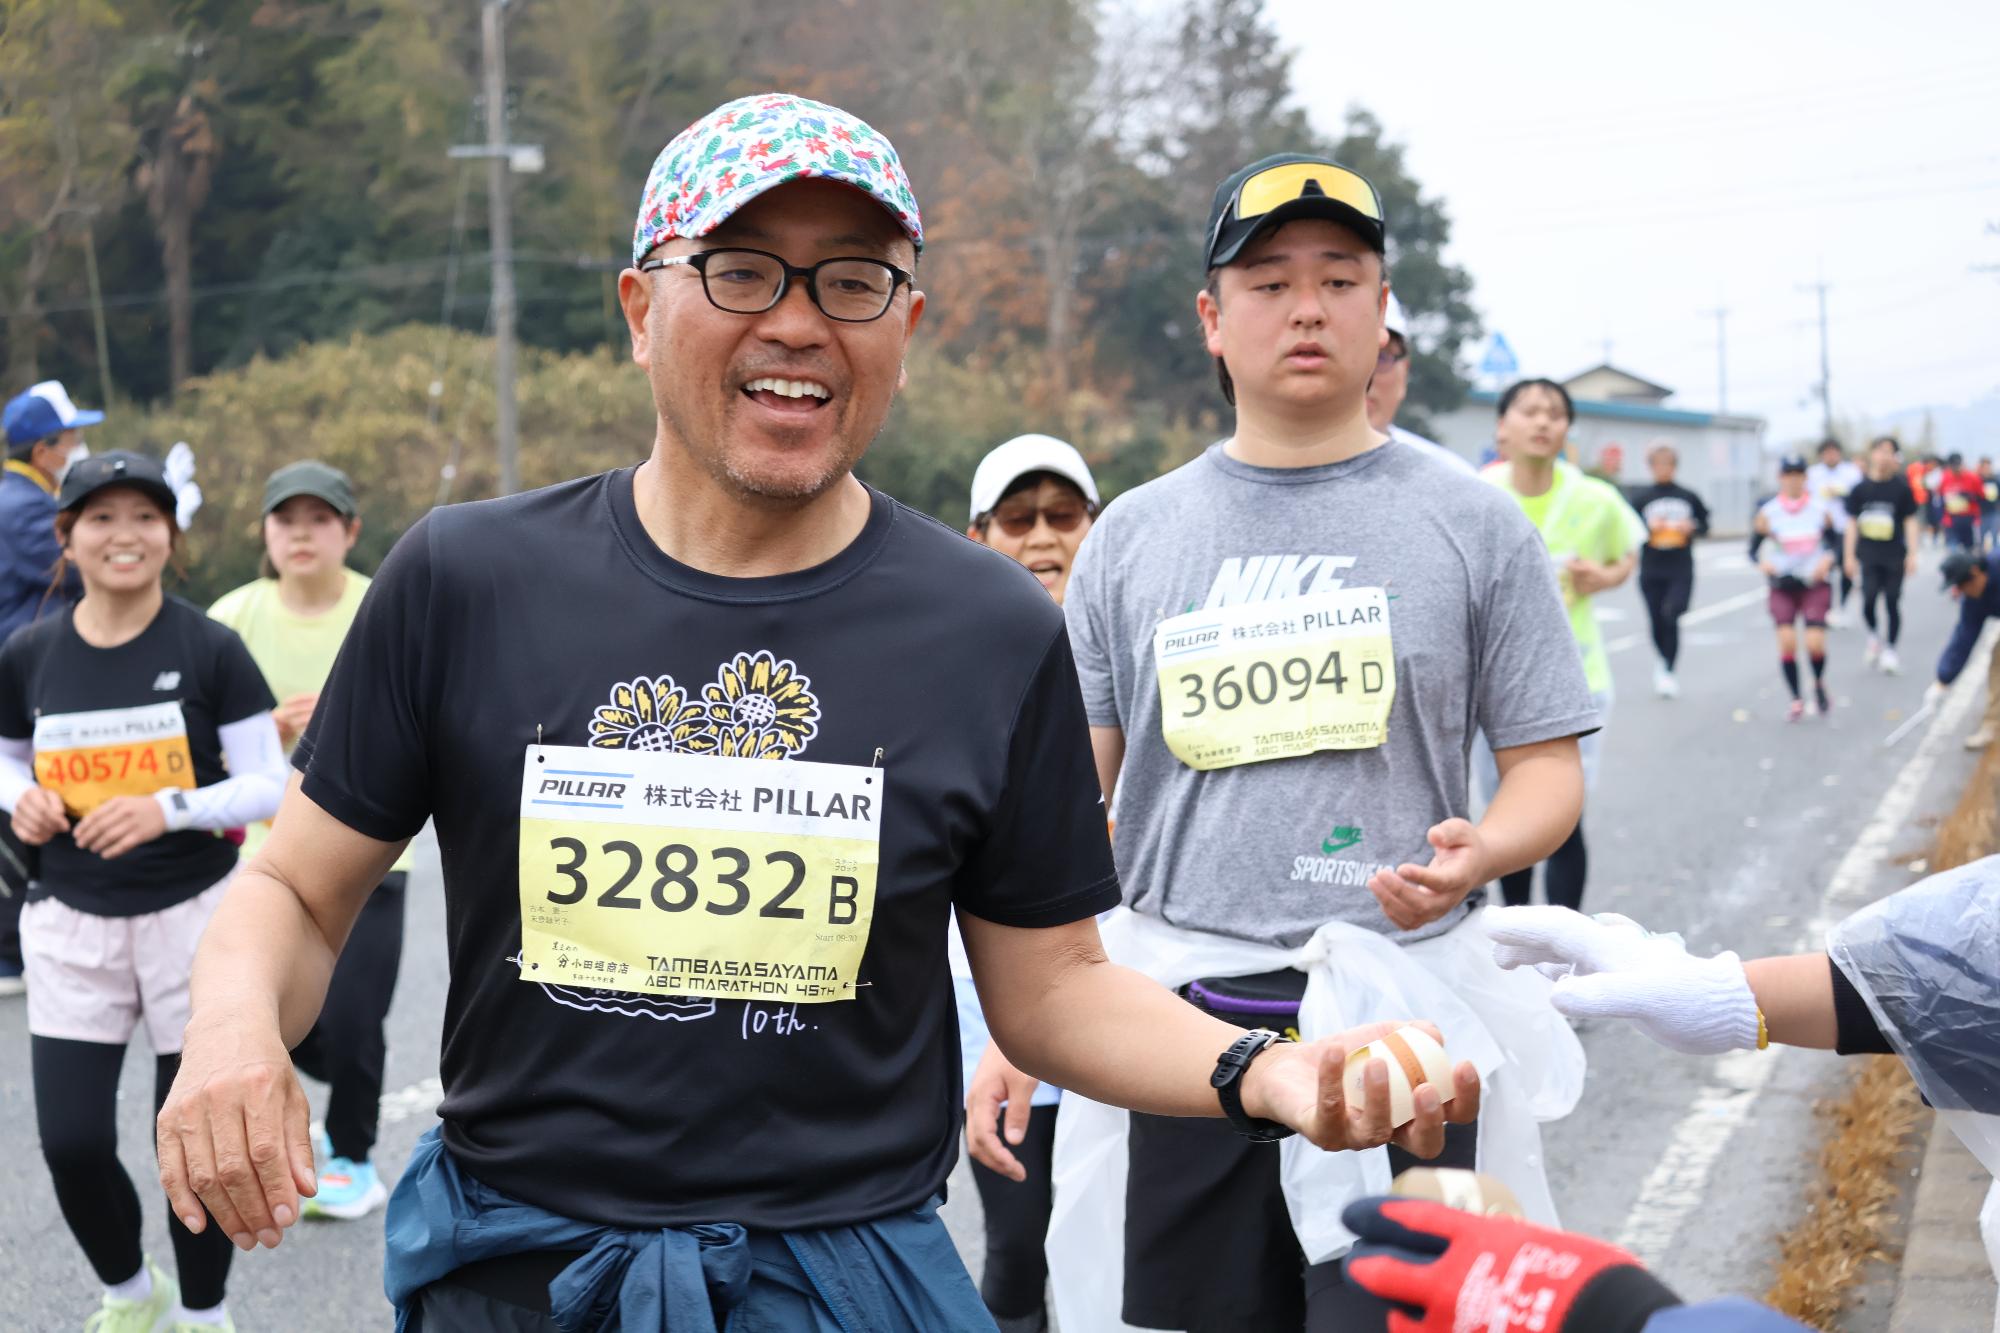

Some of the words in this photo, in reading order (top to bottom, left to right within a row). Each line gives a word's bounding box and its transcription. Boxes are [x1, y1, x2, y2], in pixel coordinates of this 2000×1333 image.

[1203, 555, 1357, 610] NIKE
[1165, 631, 1219, 650] PILLAR
[1231, 620, 1297, 640] 株式会社
[1303, 606, 1382, 632] PILLAR
[1179, 651, 1348, 718] 36094
[1361, 661, 1383, 693] D
[46, 747, 158, 785] 40574
[167, 751, 184, 774] D
[539, 778, 626, 799] PILLAR
[643, 783, 743, 812] 株式会社
[753, 787, 871, 821] PILLAR
[546, 836, 806, 920] 32832
[1290, 855, 1395, 888] SPORTSWE
[828, 875, 858, 925] B
[644, 975, 681, 989] ABC
[688, 979, 788, 995] MARATHON
[795, 984, 835, 996] 45TH
[647, 956, 838, 981] TAMBASASAYAMA
